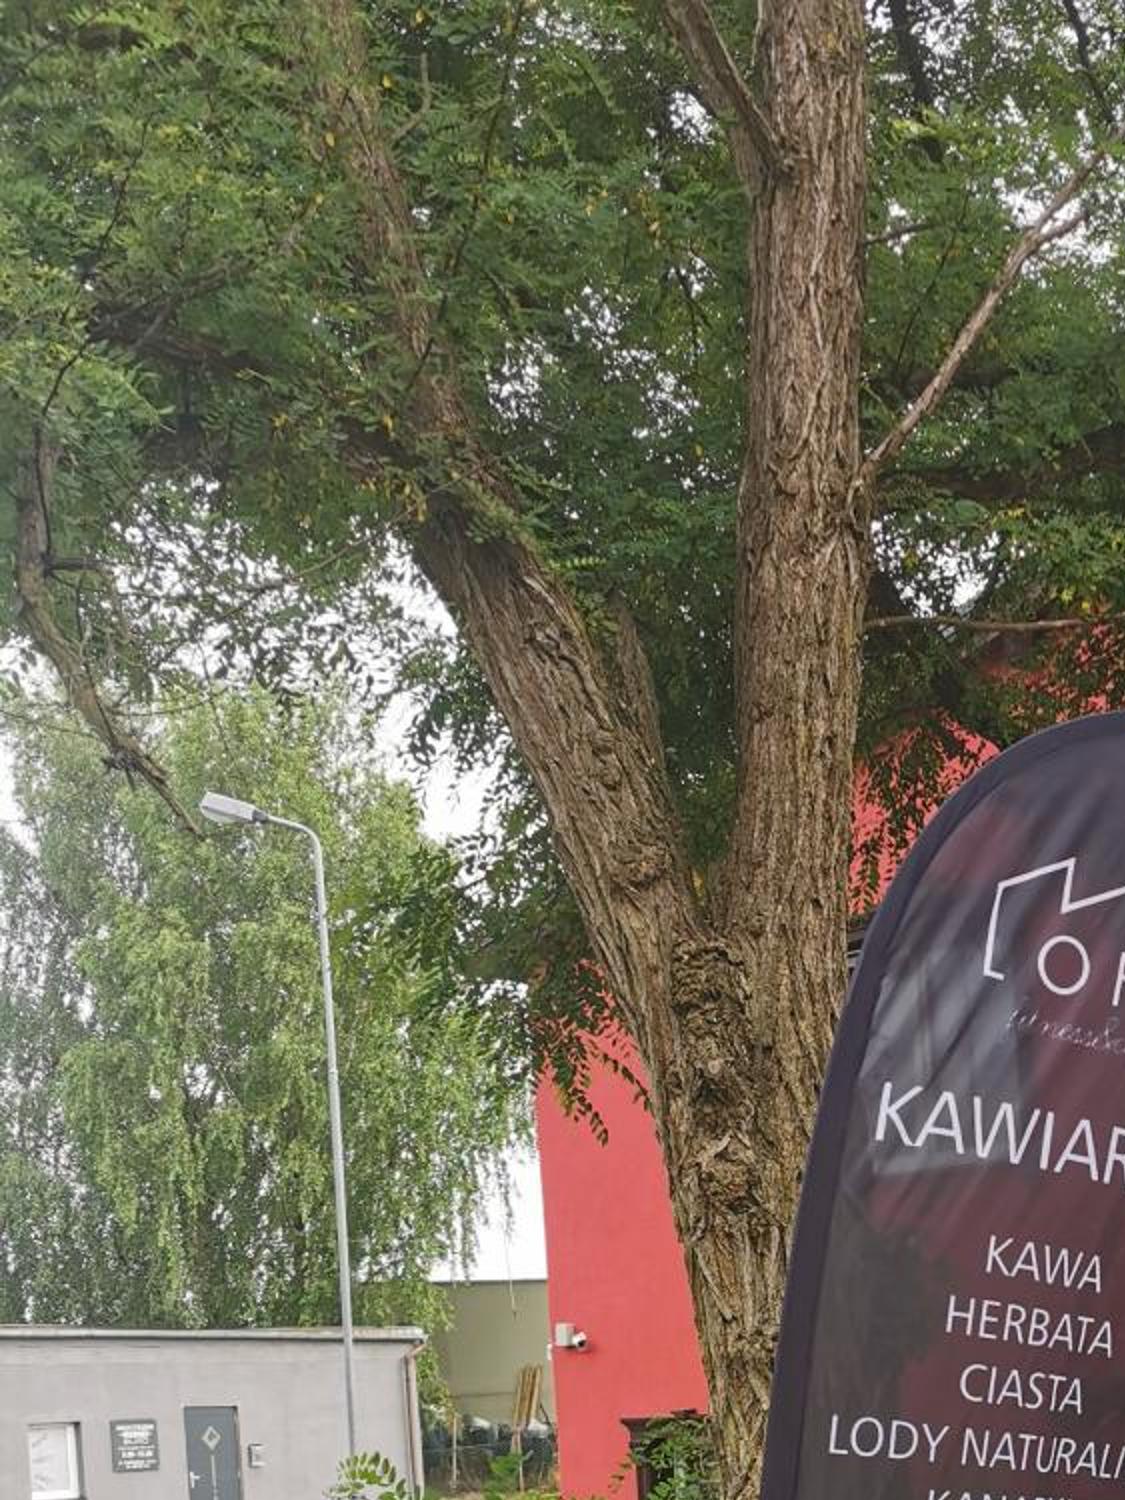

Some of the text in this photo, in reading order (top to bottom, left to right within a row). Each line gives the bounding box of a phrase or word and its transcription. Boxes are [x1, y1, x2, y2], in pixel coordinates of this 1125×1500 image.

[984, 1234, 1101, 1293] KAWA
[944, 1295, 1113, 1358] HERBATA
[958, 1363, 1083, 1415] CIASTA
[828, 1414, 950, 1463] LODY
